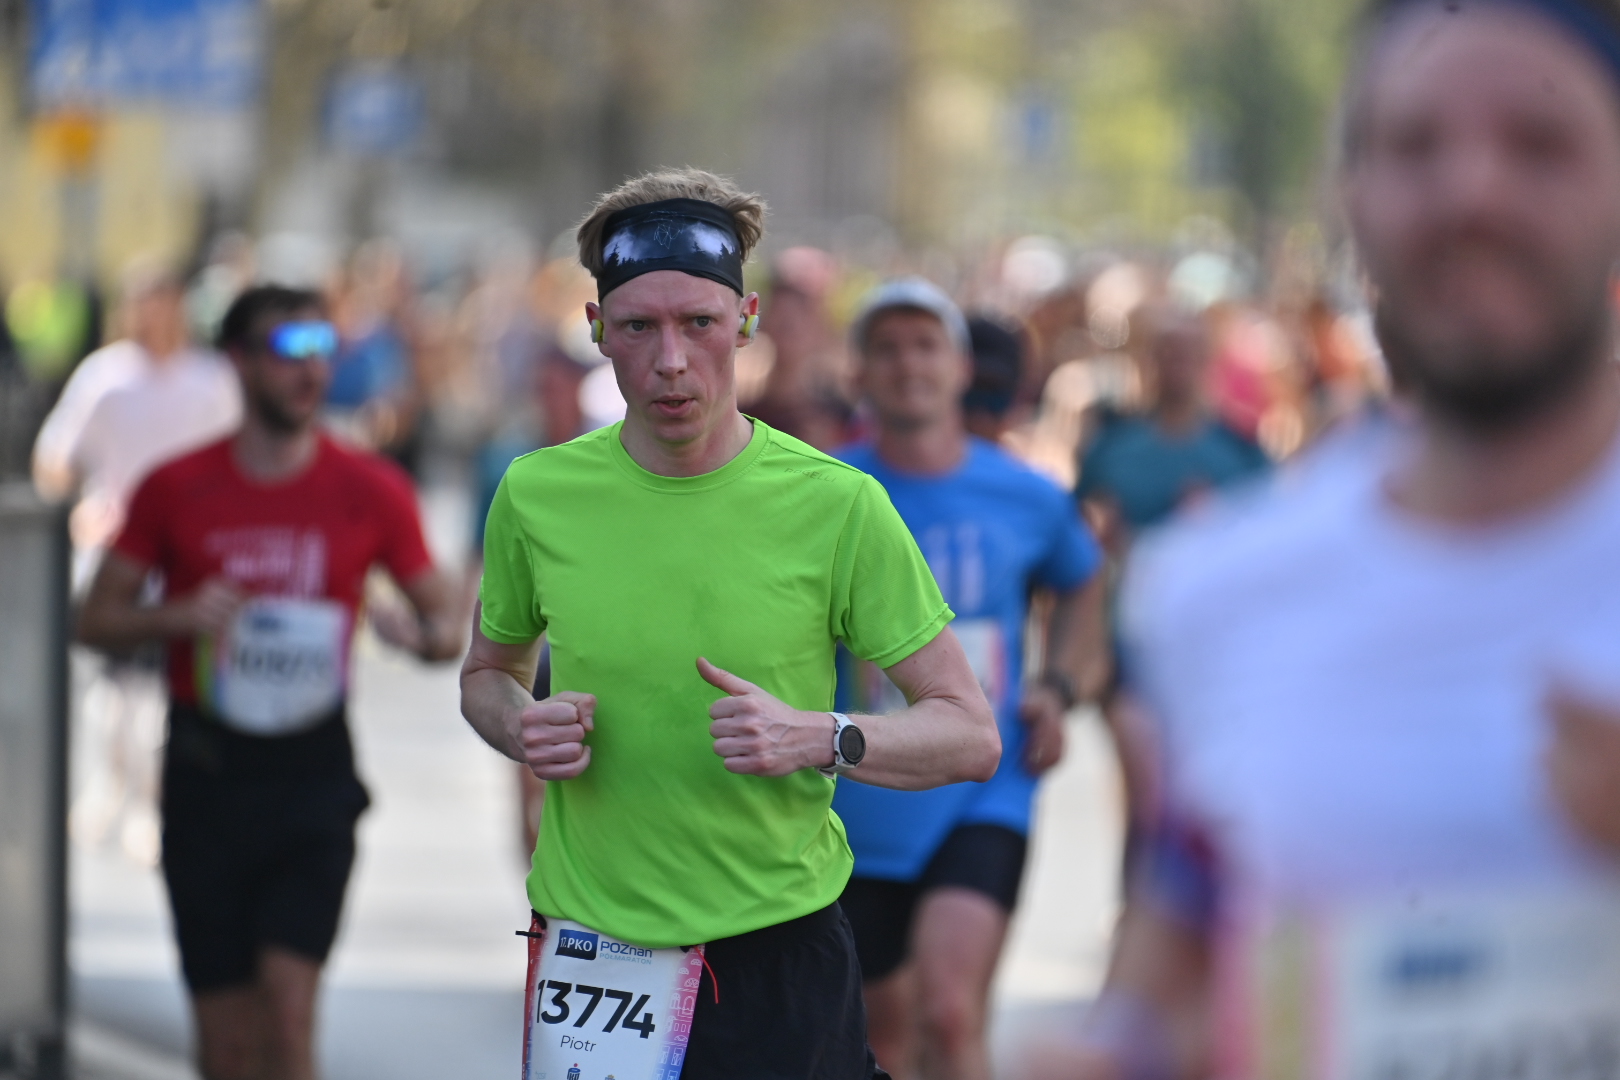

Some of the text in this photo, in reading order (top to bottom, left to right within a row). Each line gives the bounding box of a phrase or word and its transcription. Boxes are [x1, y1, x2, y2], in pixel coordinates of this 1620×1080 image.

[567, 937, 593, 952] PKO
[537, 979, 656, 1039] 13774
[560, 1034, 597, 1052] Piotr
